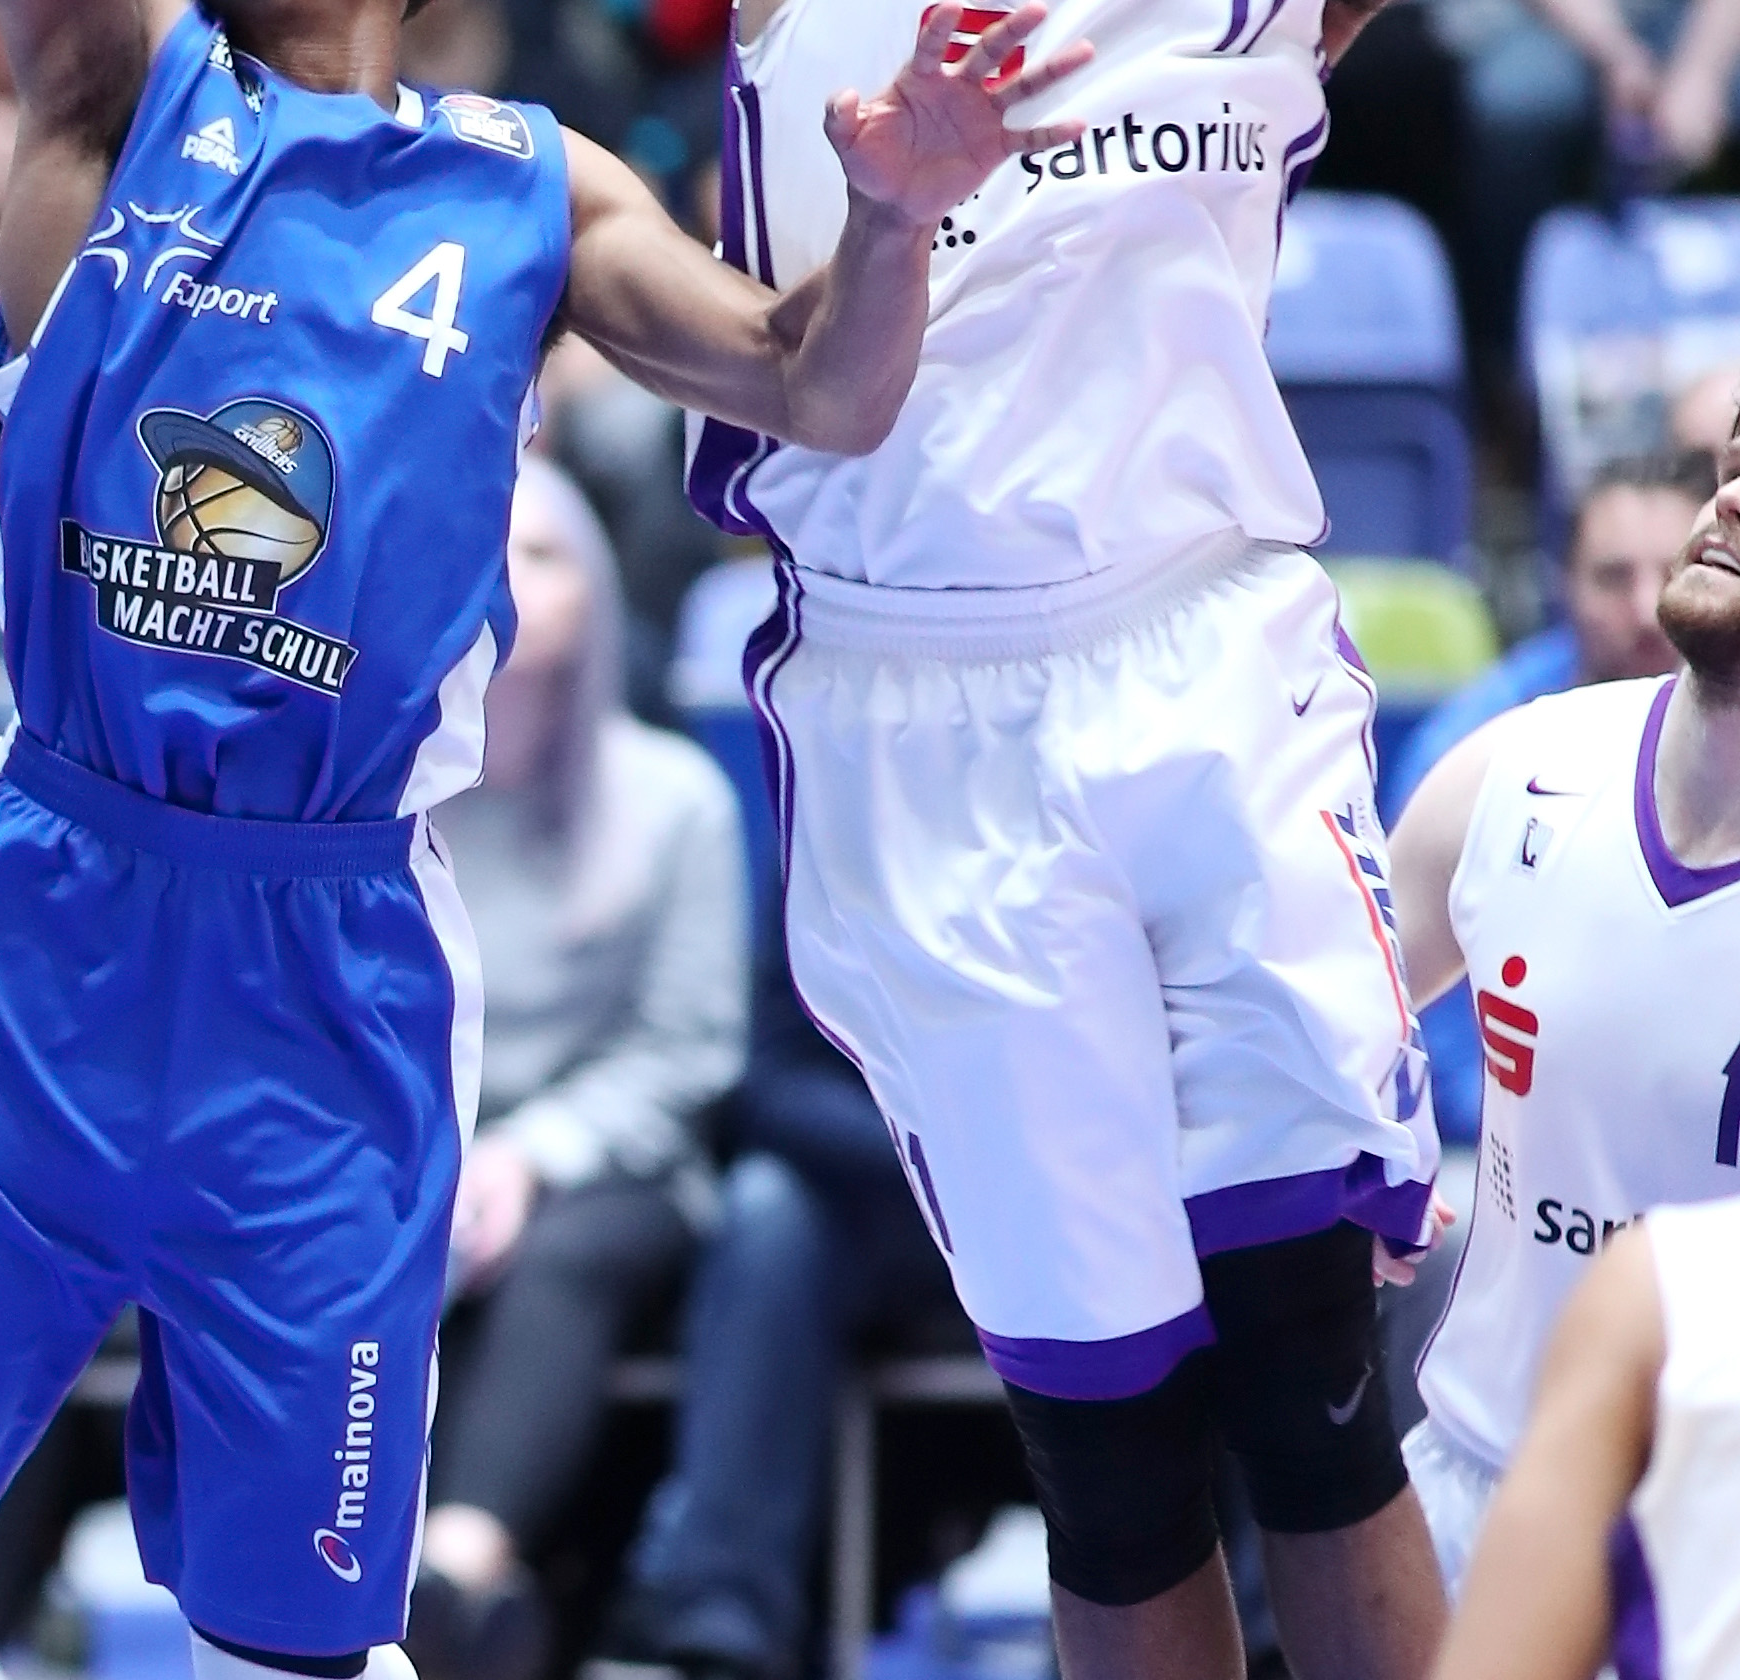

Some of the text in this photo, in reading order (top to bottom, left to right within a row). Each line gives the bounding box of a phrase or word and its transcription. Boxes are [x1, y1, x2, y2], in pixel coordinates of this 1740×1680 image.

[180, 133, 243, 177] PEAK
[371, 240, 469, 378] 4
[113, 590, 236, 650] MACHT
[335, 1341, 380, 1529] mainova
